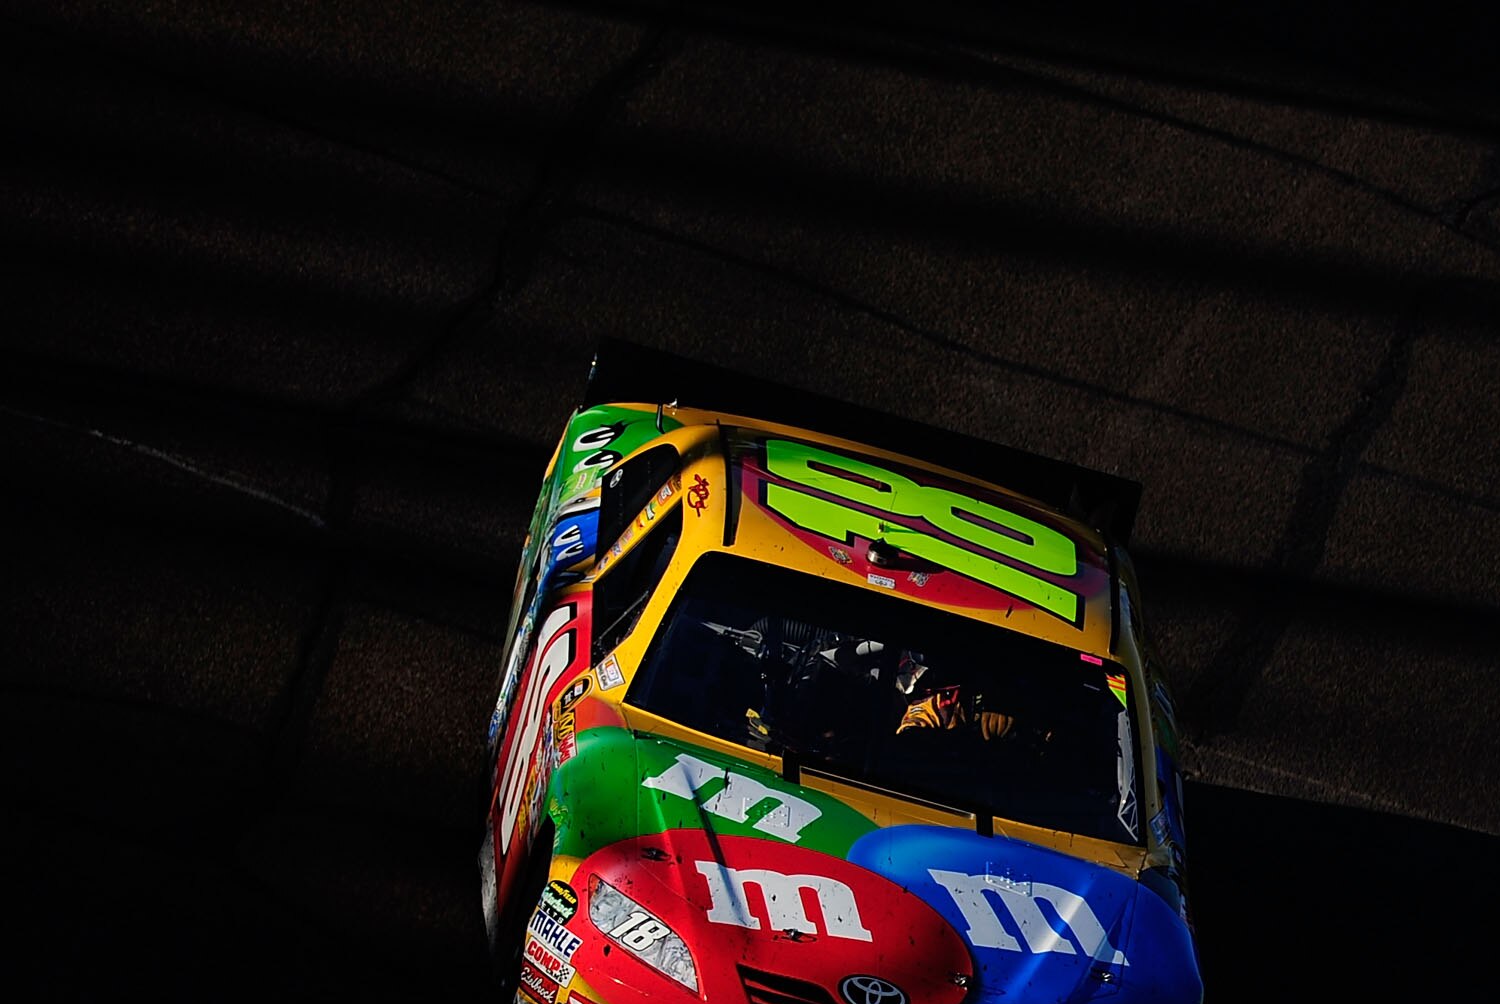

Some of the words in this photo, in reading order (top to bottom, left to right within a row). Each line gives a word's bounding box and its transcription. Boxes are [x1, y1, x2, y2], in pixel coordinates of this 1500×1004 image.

[759, 438, 1083, 629] 18
[641, 753, 822, 843] m
[541, 901, 565, 925] ELTS
[694, 860, 873, 942] m
[927, 868, 1130, 966] m
[530, 910, 581, 958] MAHLE
[608, 909, 672, 952] 18
[527, 940, 561, 972] COMP
[521, 966, 556, 1004] Edelbrock
